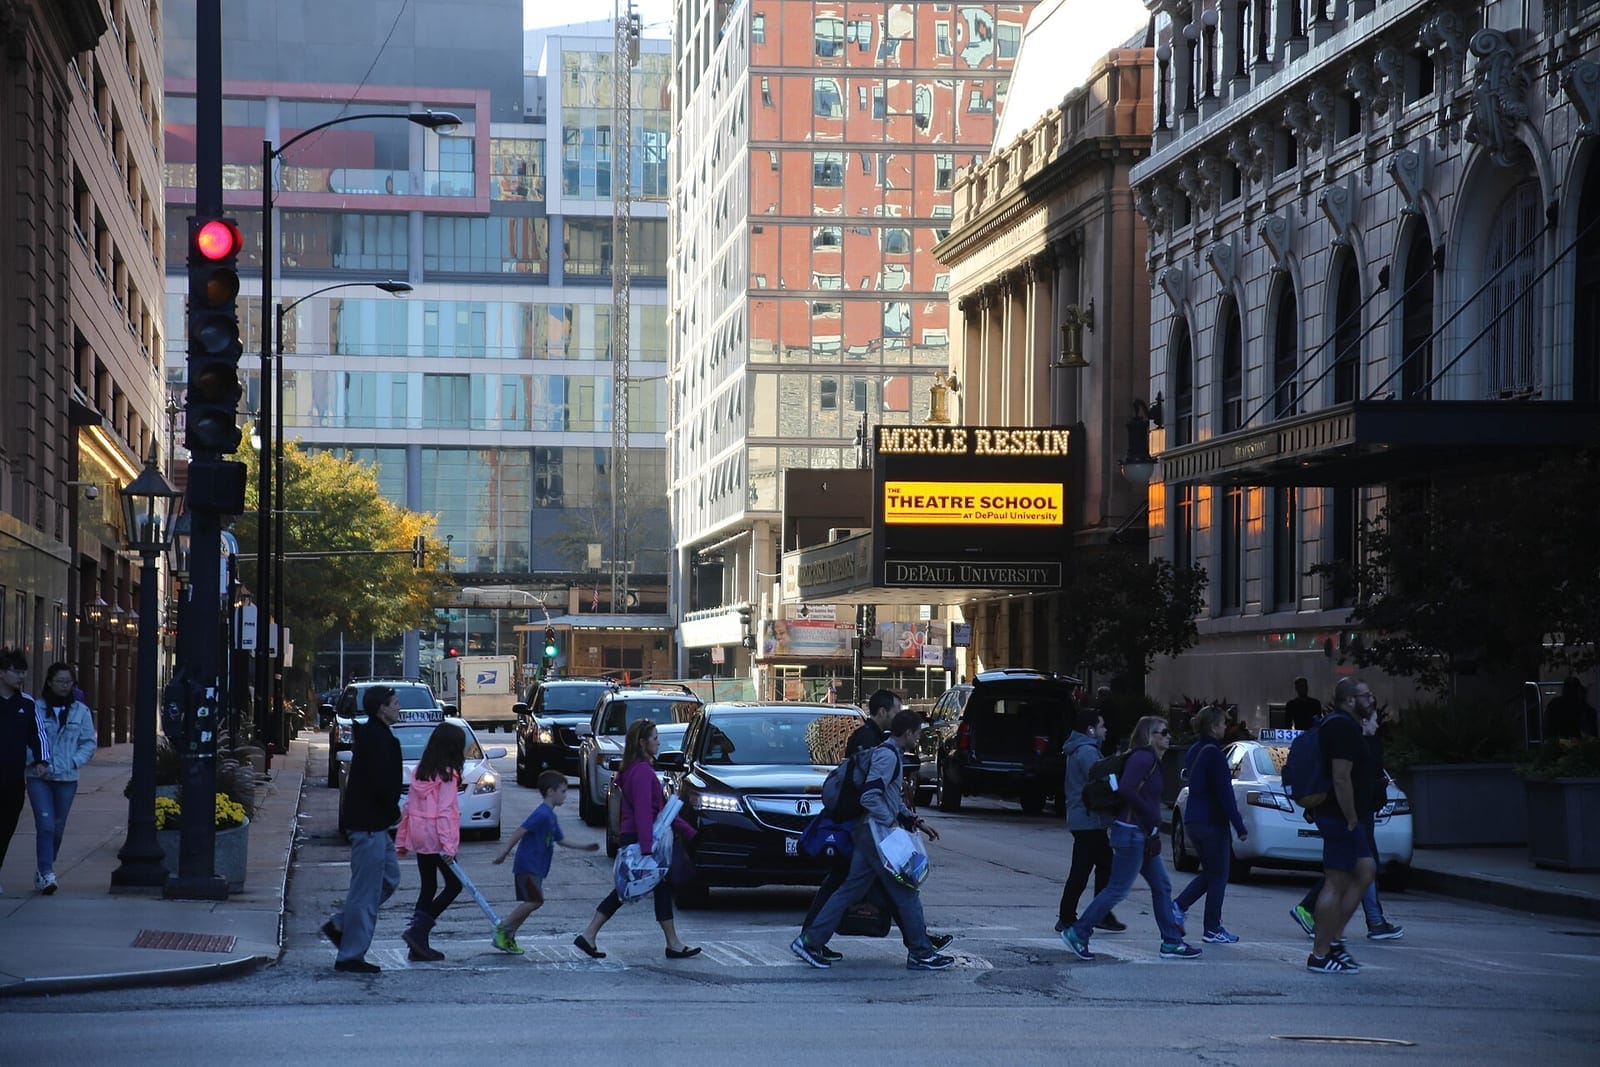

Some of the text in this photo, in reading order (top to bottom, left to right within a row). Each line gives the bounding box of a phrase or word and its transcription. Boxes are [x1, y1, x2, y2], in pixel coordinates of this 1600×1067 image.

[879, 428, 1070, 455] MERLE RESKIN
[888, 496, 1057, 509] THEATRE SCHOOL
[975, 511, 1008, 519] DePaul
[1010, 512, 1057, 521] University
[960, 565, 1049, 583] UNIVERSITY
[1262, 730, 1275, 739] TAXI
